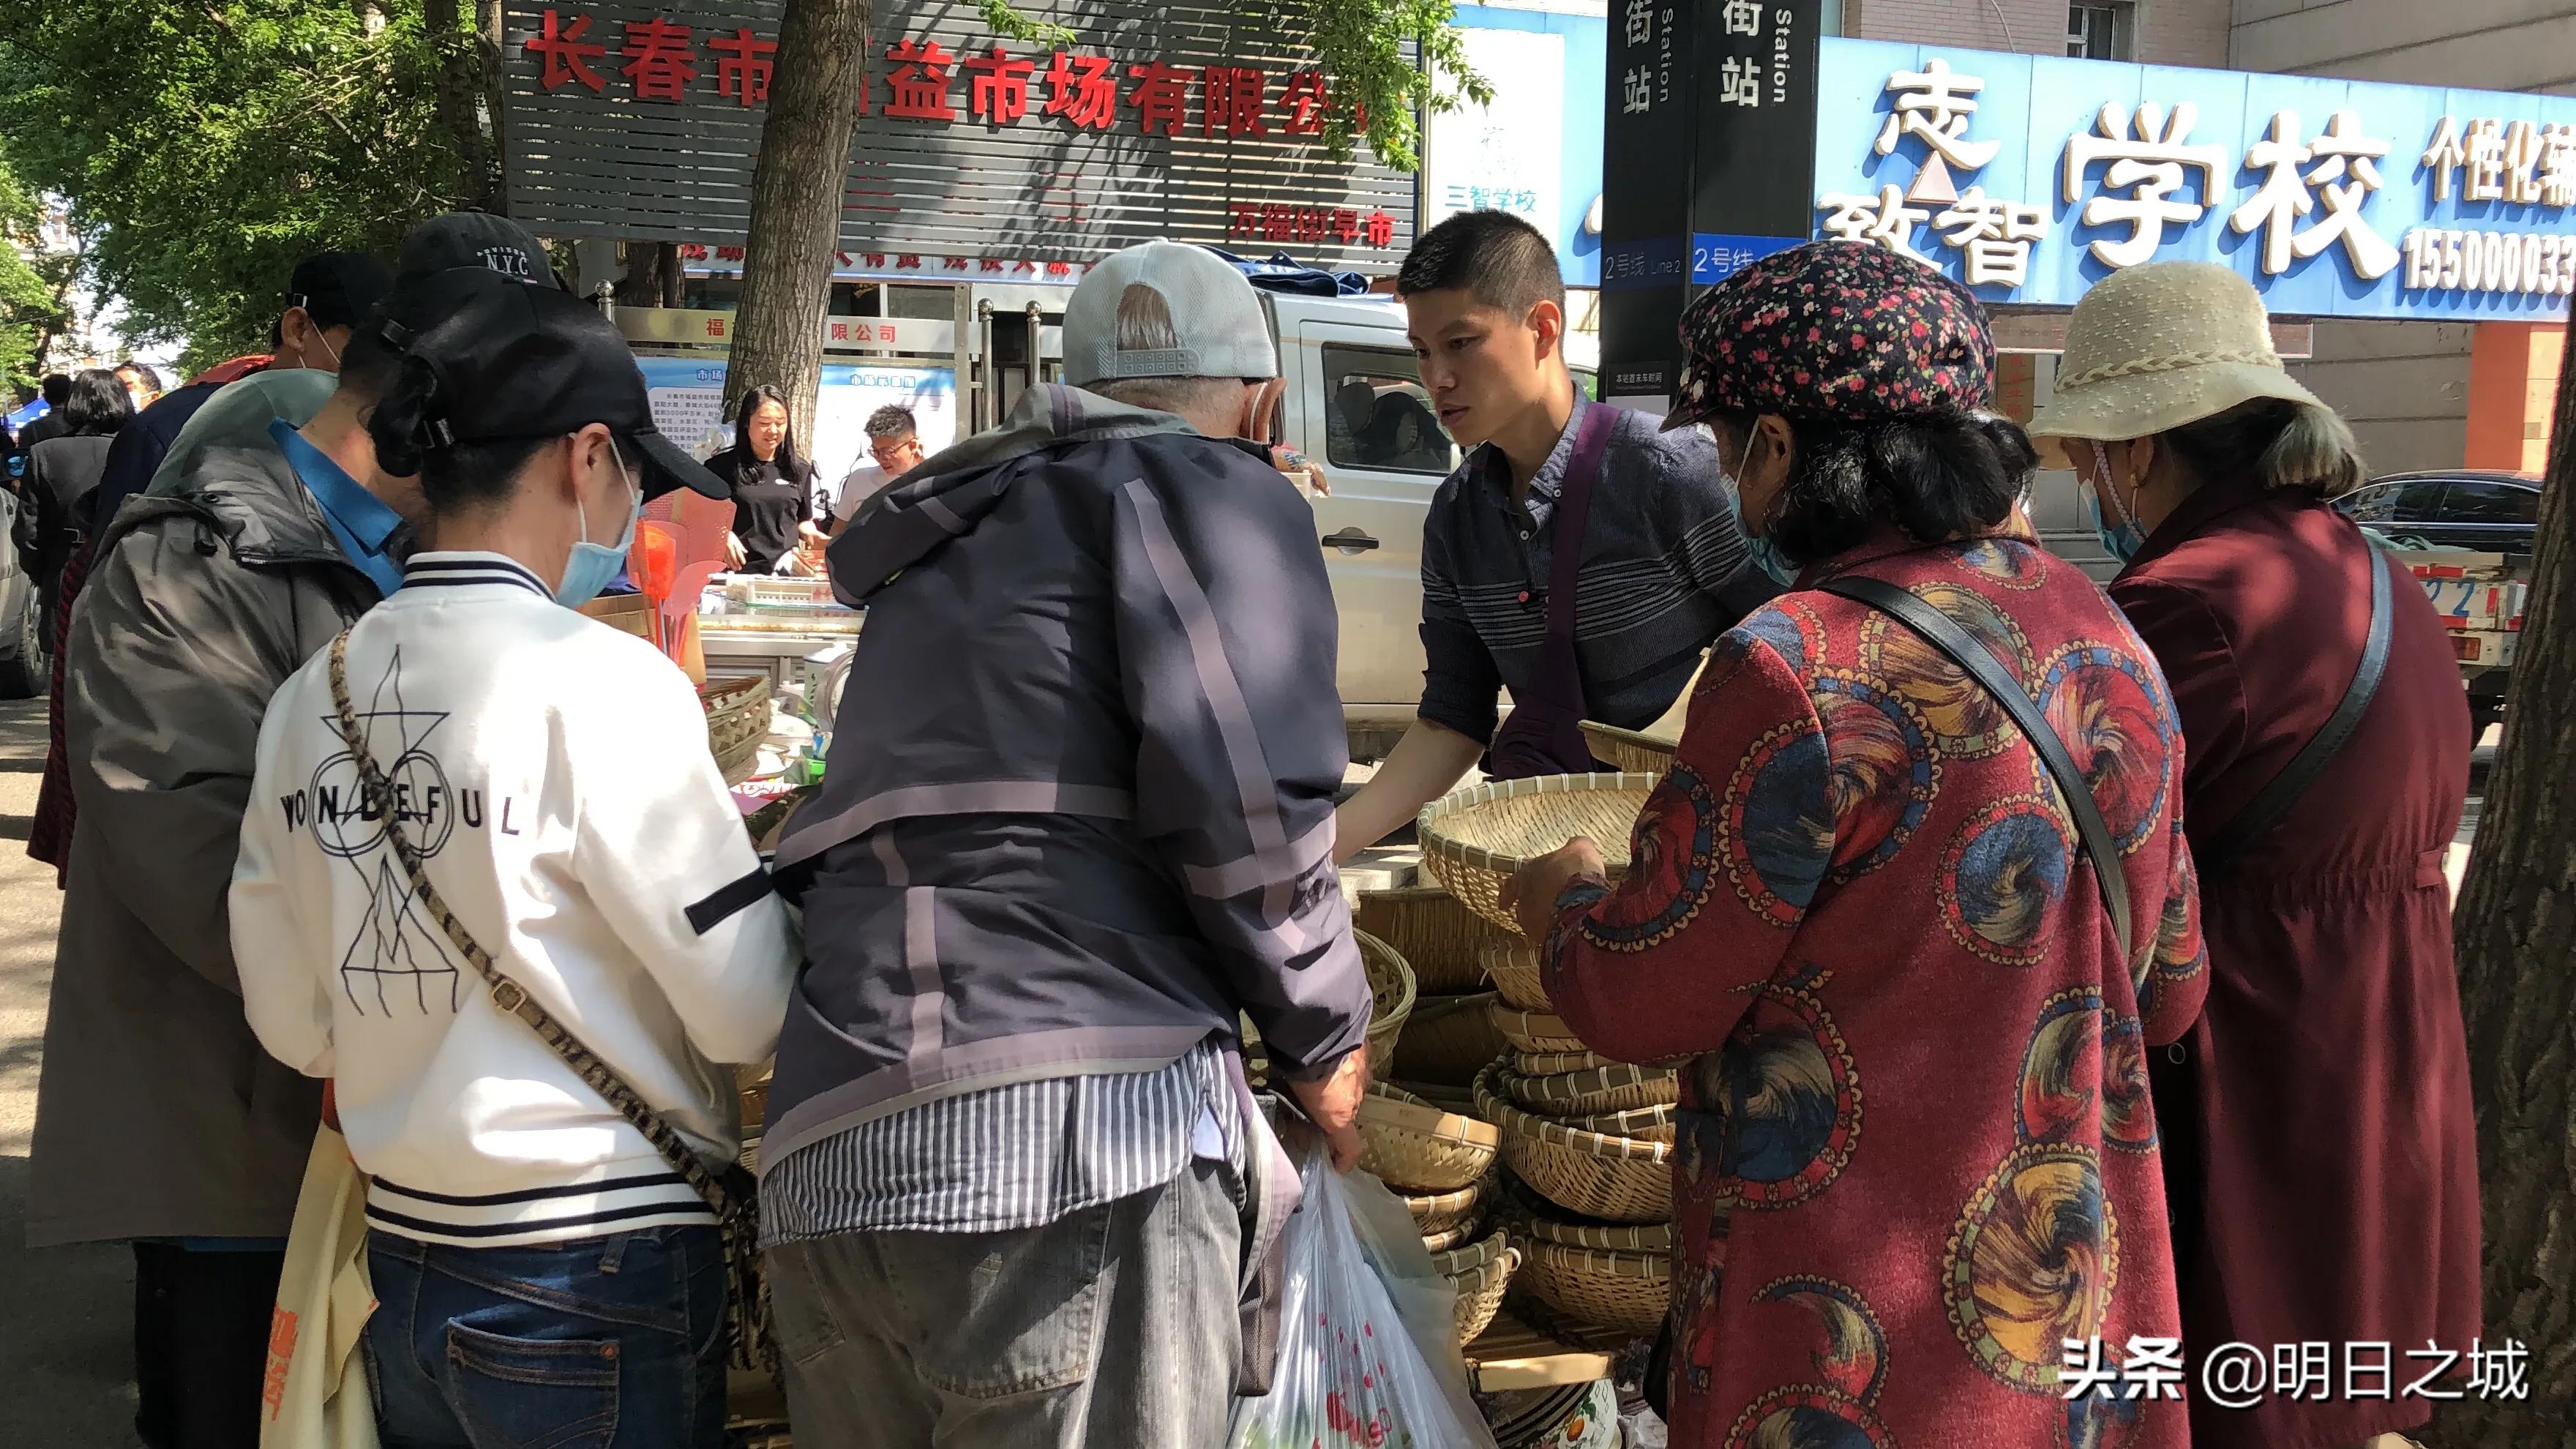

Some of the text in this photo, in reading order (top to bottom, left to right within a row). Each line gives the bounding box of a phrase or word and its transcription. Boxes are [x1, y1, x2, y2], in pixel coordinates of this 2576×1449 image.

[1659, 7, 1674, 102] Station
[1773, 8, 1793, 102] Station
[1229, 204, 1396, 246] 万福街早市
[1445, 185, 1538, 213] 三智学校
[2062, 101, 2400, 280] 学校
